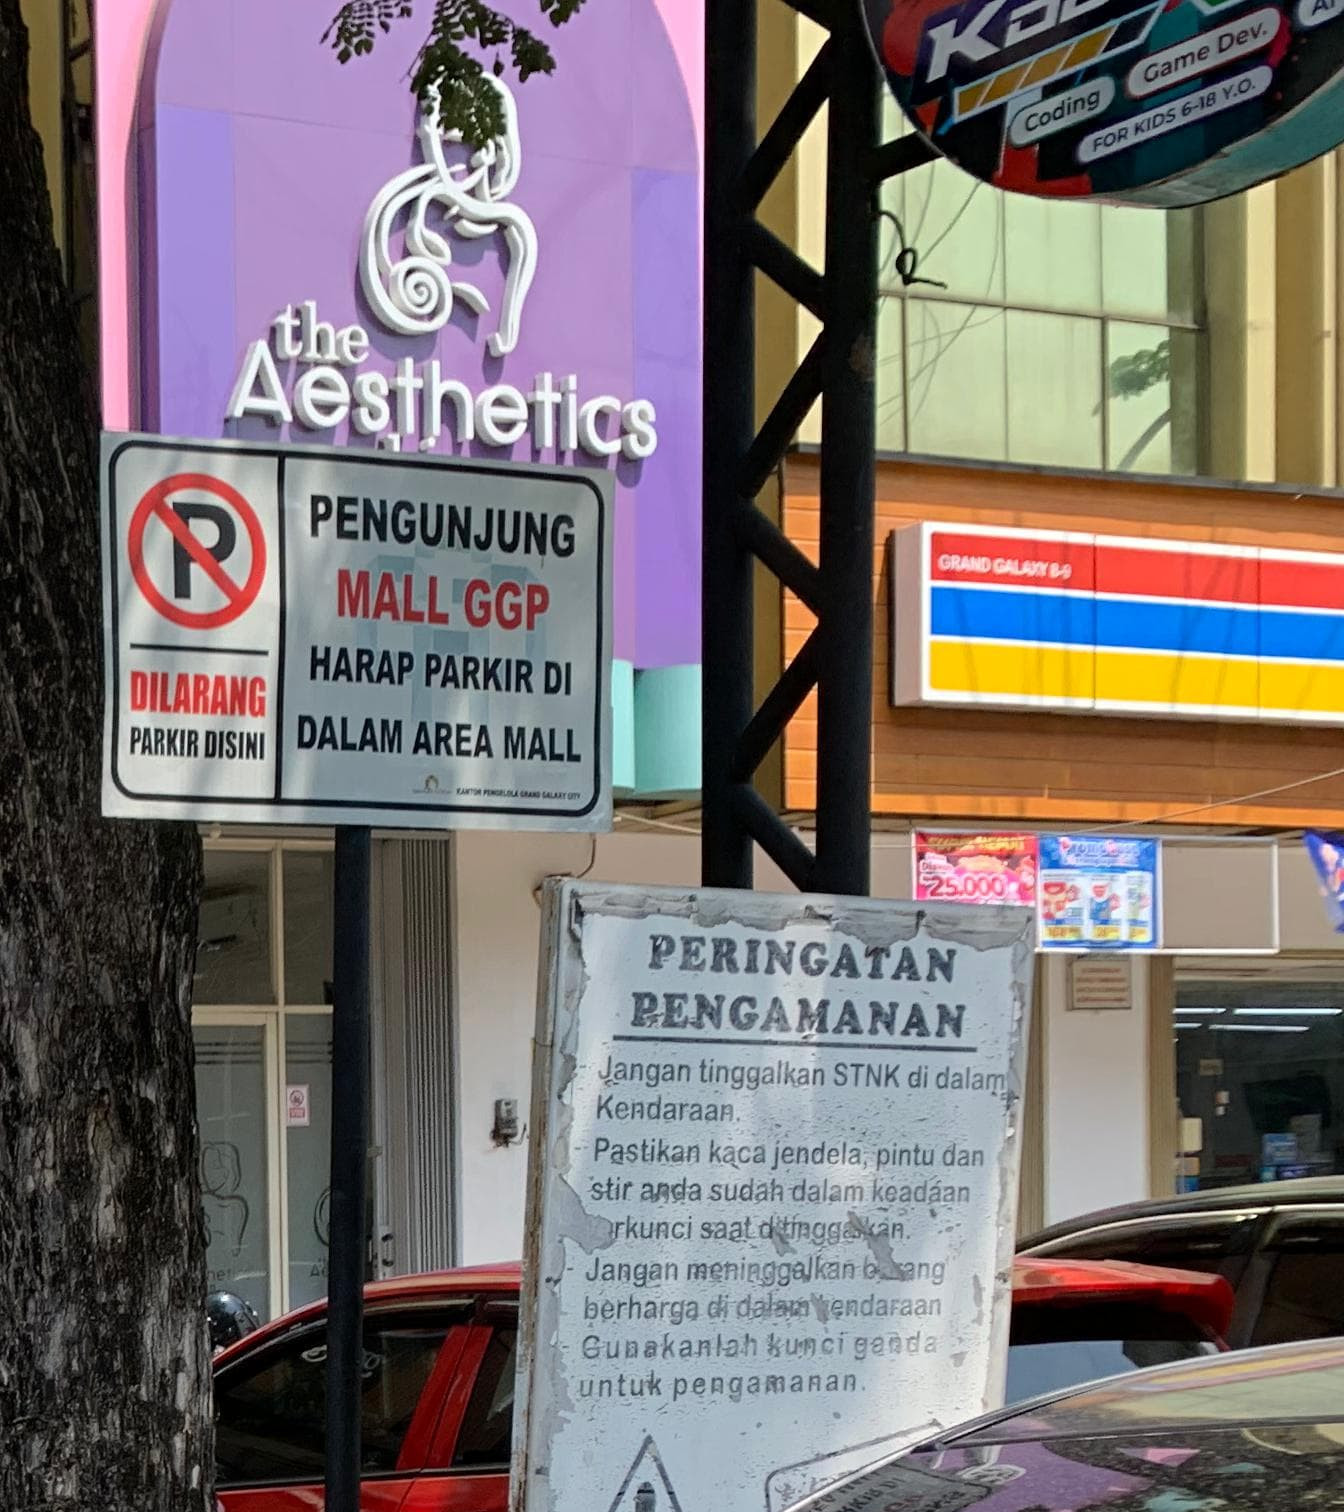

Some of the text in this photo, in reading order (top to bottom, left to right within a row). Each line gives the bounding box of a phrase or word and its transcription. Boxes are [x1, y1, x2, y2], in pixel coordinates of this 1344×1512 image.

[1143, 22, 1267, 83] Game Dev.
[1024, 89, 1101, 132] Coding
[1093, 78, 1256, 153] FOR KIDS 6-18 Y.O.
[272, 300, 370, 365] the
[226, 339, 658, 460] Aesthetics
[310, 494, 575, 558] PENGUNJUNG
[938, 554, 992, 574] GRAND
[993, 557, 1049, 577] GALAXY
[336, 569, 550, 632] MALL GGP
[309, 645, 572, 696] HARAP PARKIR DI
[130, 670, 266, 718] DILARANG
[130, 726, 266, 761] PARKIR DISINI
[297, 715, 582, 763] DALAM AREA MALL
[456, 788, 482, 796] KANTOR
[648, 934, 956, 983] PERINGATAN
[630, 991, 966, 1039] PENGAMANAN
[598, 1056, 1005, 1091] Jangan tinggalkan STNK di dalam
[597, 1094, 741, 1122] Kendaraan.
[594, 1138, 984, 1171] Pastikan kaca jendela, pintu dan
[591, 1177, 970, 1203] stir anda sudah dalam keadaan
[612, 1215, 692, 1240] rkunci
[700, 1216, 752, 1240] saat
[586, 1256, 945, 1287] Jangan meninggalkan bang
[584, 1293, 941, 1325] berharga di dalam endaraan
[582, 1331, 937, 1360] Gunakanlah kunci ganda
[580, 1370, 865, 1402] untuk pengamanan.
